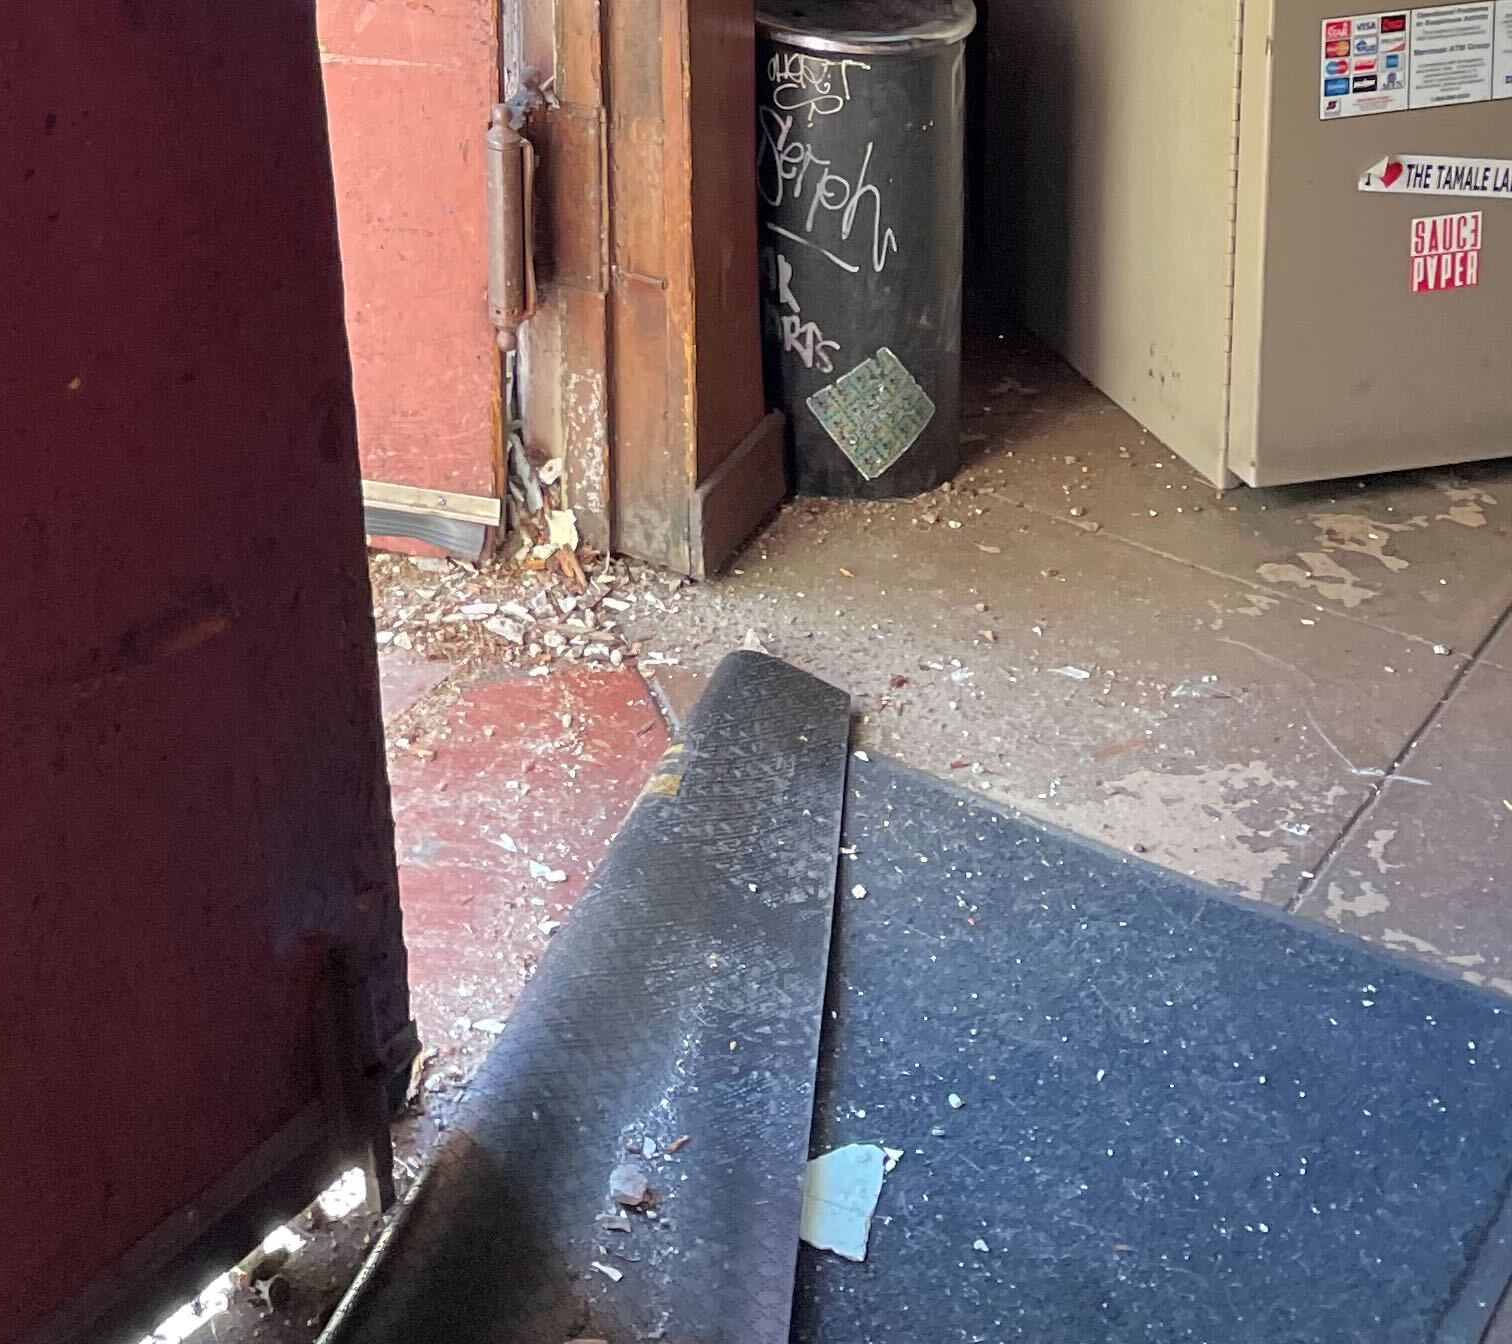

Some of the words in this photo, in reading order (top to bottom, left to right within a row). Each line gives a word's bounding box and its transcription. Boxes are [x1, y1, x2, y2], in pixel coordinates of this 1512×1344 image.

[1406, 164, 1433, 189] THE
[1436, 165, 1491, 191] TAMALE
[1493, 167, 1512, 192] LA
